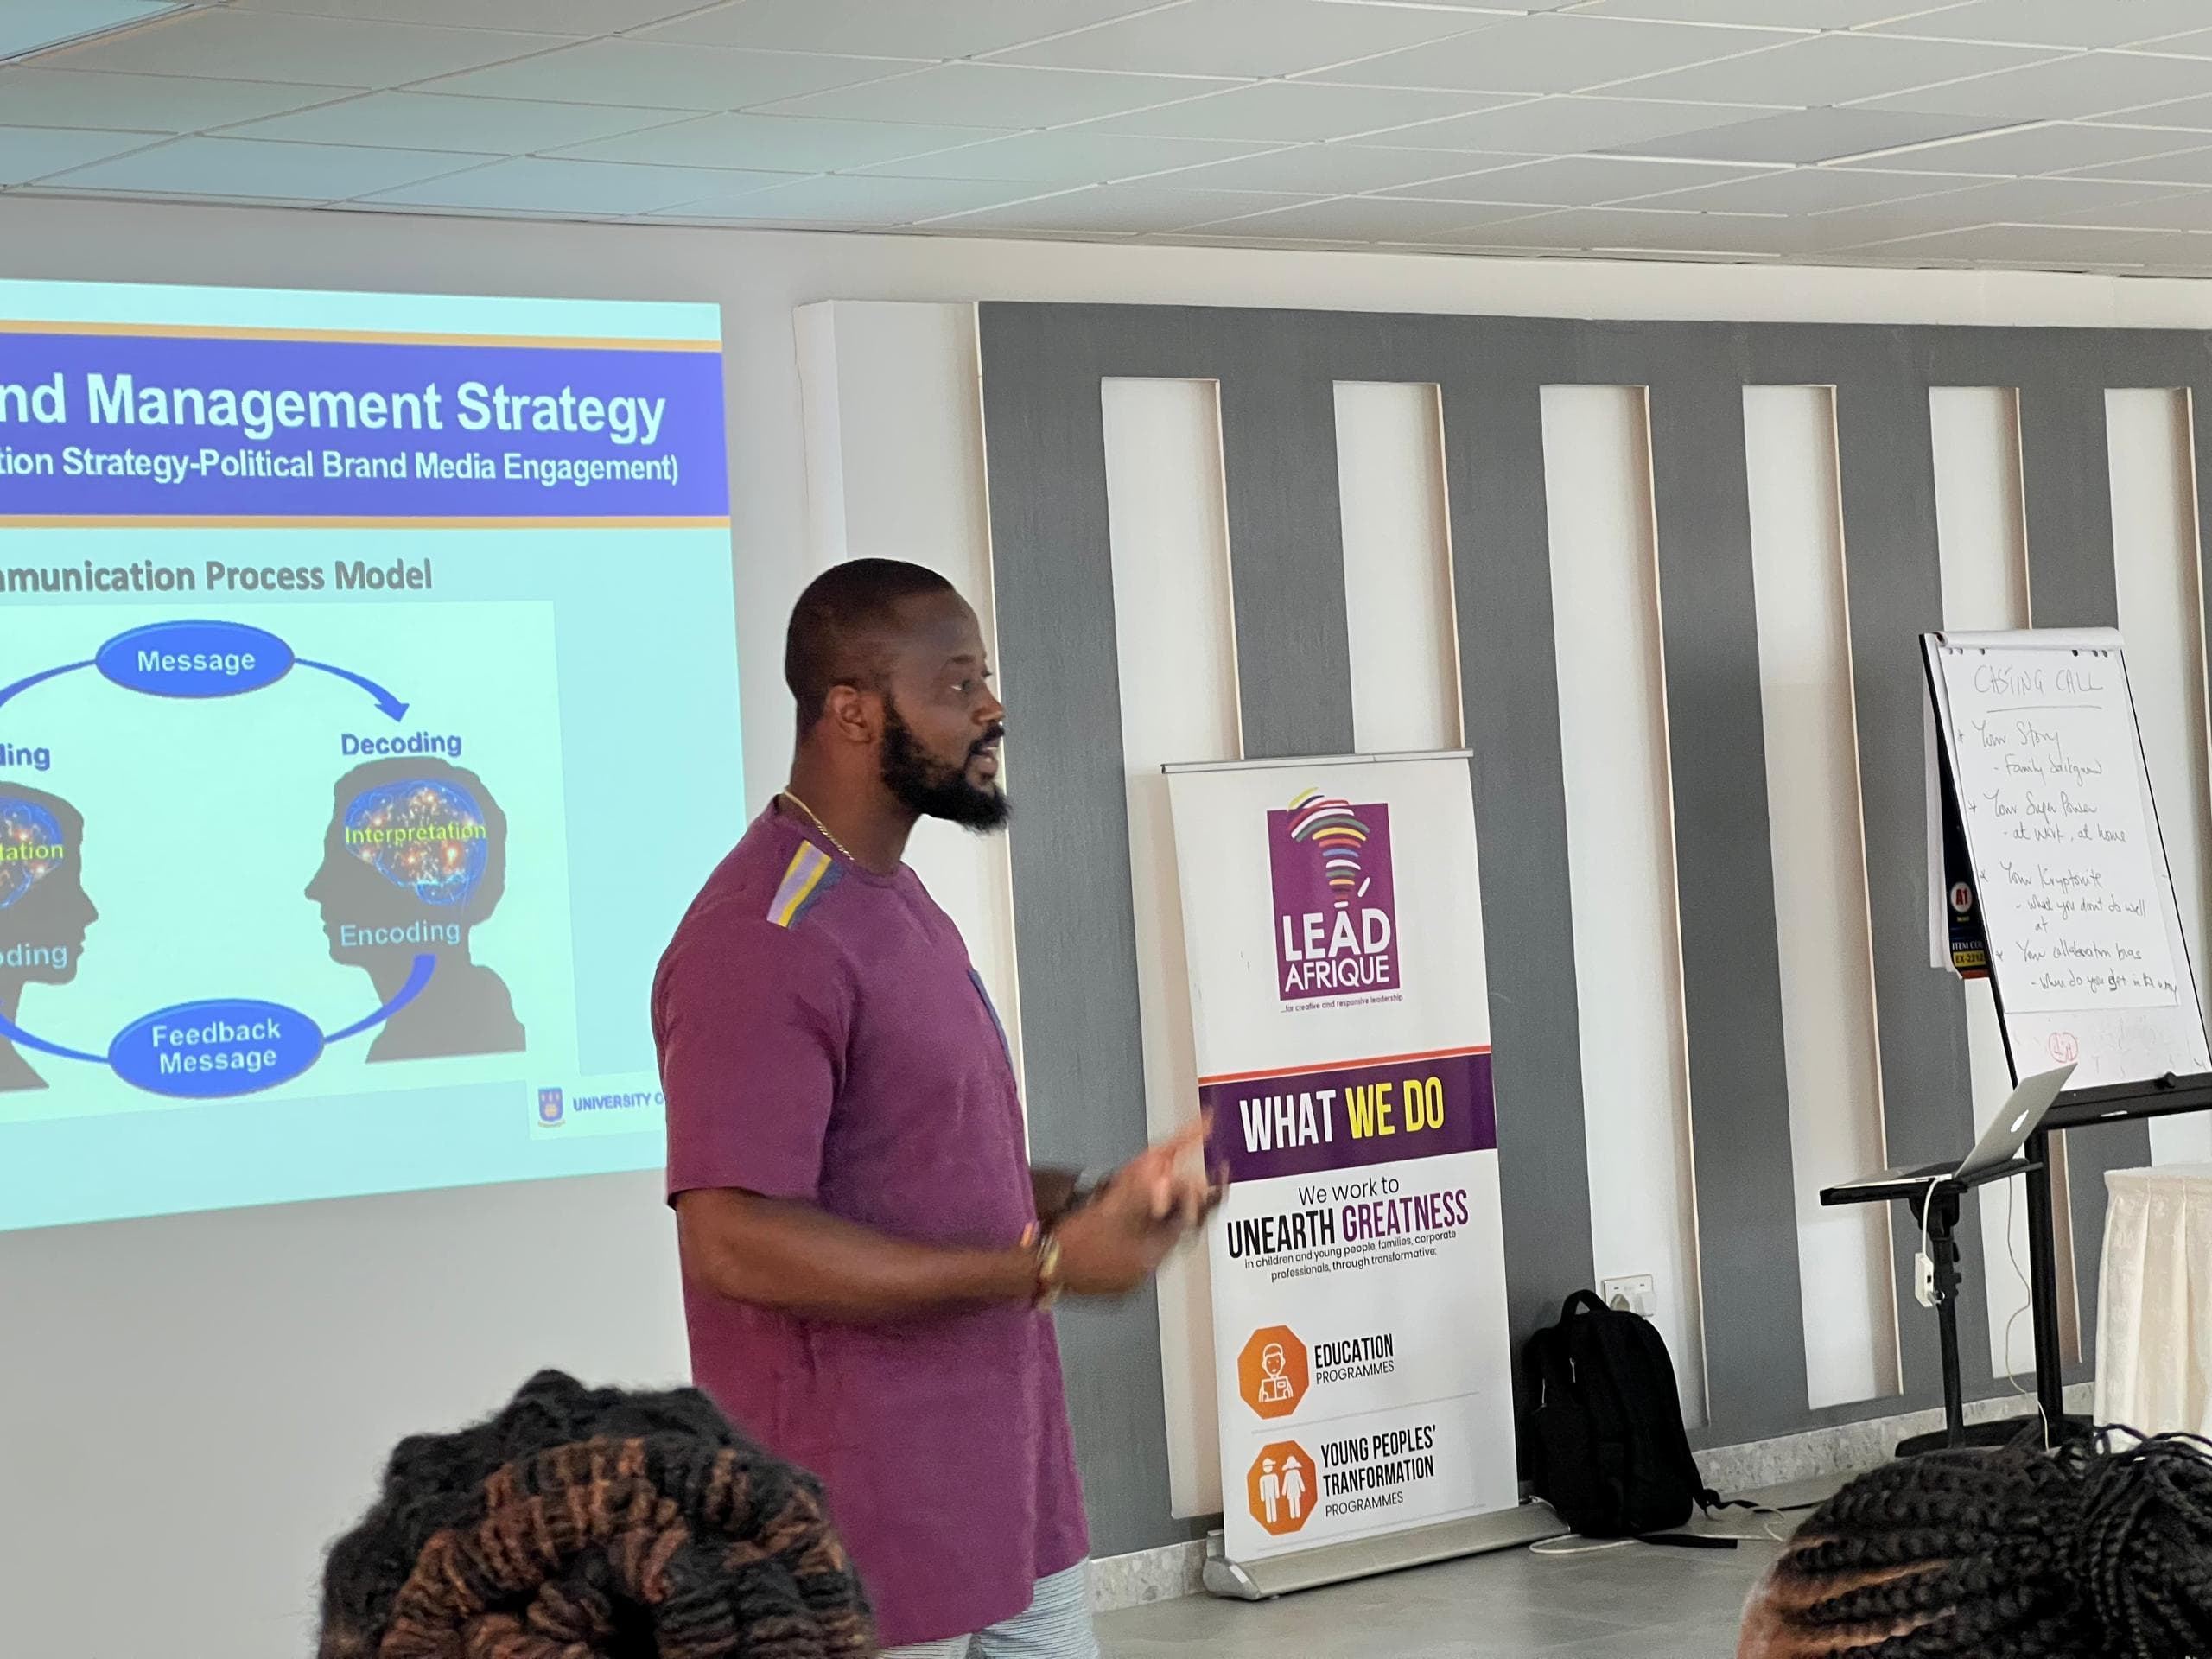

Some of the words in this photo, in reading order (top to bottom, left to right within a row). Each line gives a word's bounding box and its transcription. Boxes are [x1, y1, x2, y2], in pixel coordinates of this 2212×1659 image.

[87, 372, 442, 440] Management
[457, 380, 665, 445] Strategy
[62, 446, 314, 484] Strategy-Political
[323, 452, 407, 479] Brand
[415, 454, 497, 480] Media
[505, 453, 679, 486] Engagement)
[0, 559, 195, 593] munication
[206, 561, 325, 593] Process
[335, 557, 433, 591] Model
[137, 649, 256, 677] Message
[2056, 667, 2104, 695] CALL
[340, 731, 463, 758] Decoding
[1971, 719, 2006, 748] Your
[2016, 720, 2062, 760] Story
[2004, 753, 2046, 785] Family
[1982, 788, 2018, 817] Your
[2060, 790, 2098, 817] Power
[345, 820, 487, 847] Interpretation
[2012, 821, 2031, 841] at
[2077, 823, 2093, 841] at
[2097, 822, 2128, 843] home
[1999, 860, 2032, 886] Your
[2056, 899, 2075, 921] you
[2107, 893, 2122, 913] do
[2125, 899, 2147, 918] well
[340, 921, 461, 948] Encoding
[1282, 907, 1391, 962] LEAD
[2034, 915, 2049, 933] at
[2015, 938, 2046, 963] Your
[1284, 954, 1390, 993] AFRIQUE
[2069, 967, 2082, 987] do
[2087, 975, 2105, 993] you
[1295, 1001, 1320, 1012] creative
[1322, 1000, 1336, 1009] and
[1337, 996, 1370, 1008] responsive
[1370, 993, 1404, 1004] leadership
[152, 1018, 282, 1048] Feedback
[160, 1047, 277, 1076] Message
[572, 1092, 652, 1112] UNIVERSITY
[1239, 1089, 1337, 1154] WHAT
[1344, 1082, 1395, 1140] WE
[1403, 1076, 1445, 1133] DO
[1298, 1185, 1327, 1206] We
[1332, 1178, 1377, 1202] work
[1382, 1176, 1400, 1195] to
[1227, 1207, 1336, 1259] UNEARTH
[1342, 1188, 1469, 1243] GREATNESS
[1244, 1258, 1254, 1269] in
[1255, 1253, 1294, 1268] children
[1295, 1249, 1313, 1262] and
[1313, 1249, 1342, 1263] young
[1344, 1243, 1377, 1258] people,
[1378, 1236, 1414, 1250] families,
[1414, 1230, 1457, 1246] corporate
[1271, 1262, 1332, 1283] professionals,
[1332, 1255, 1370, 1271] through
[1313, 1332, 1395, 1370] EDUCATION
[1315, 1359, 1395, 1385] PROGRAMMES
[1320, 1437, 1370, 1469] YOUNG
[1372, 1424, 1436, 1458] PEOPLES'
[1323, 1454, 1434, 1497] TRANFORMATION
[1325, 1491, 1404, 1518] PROGRAMMES
